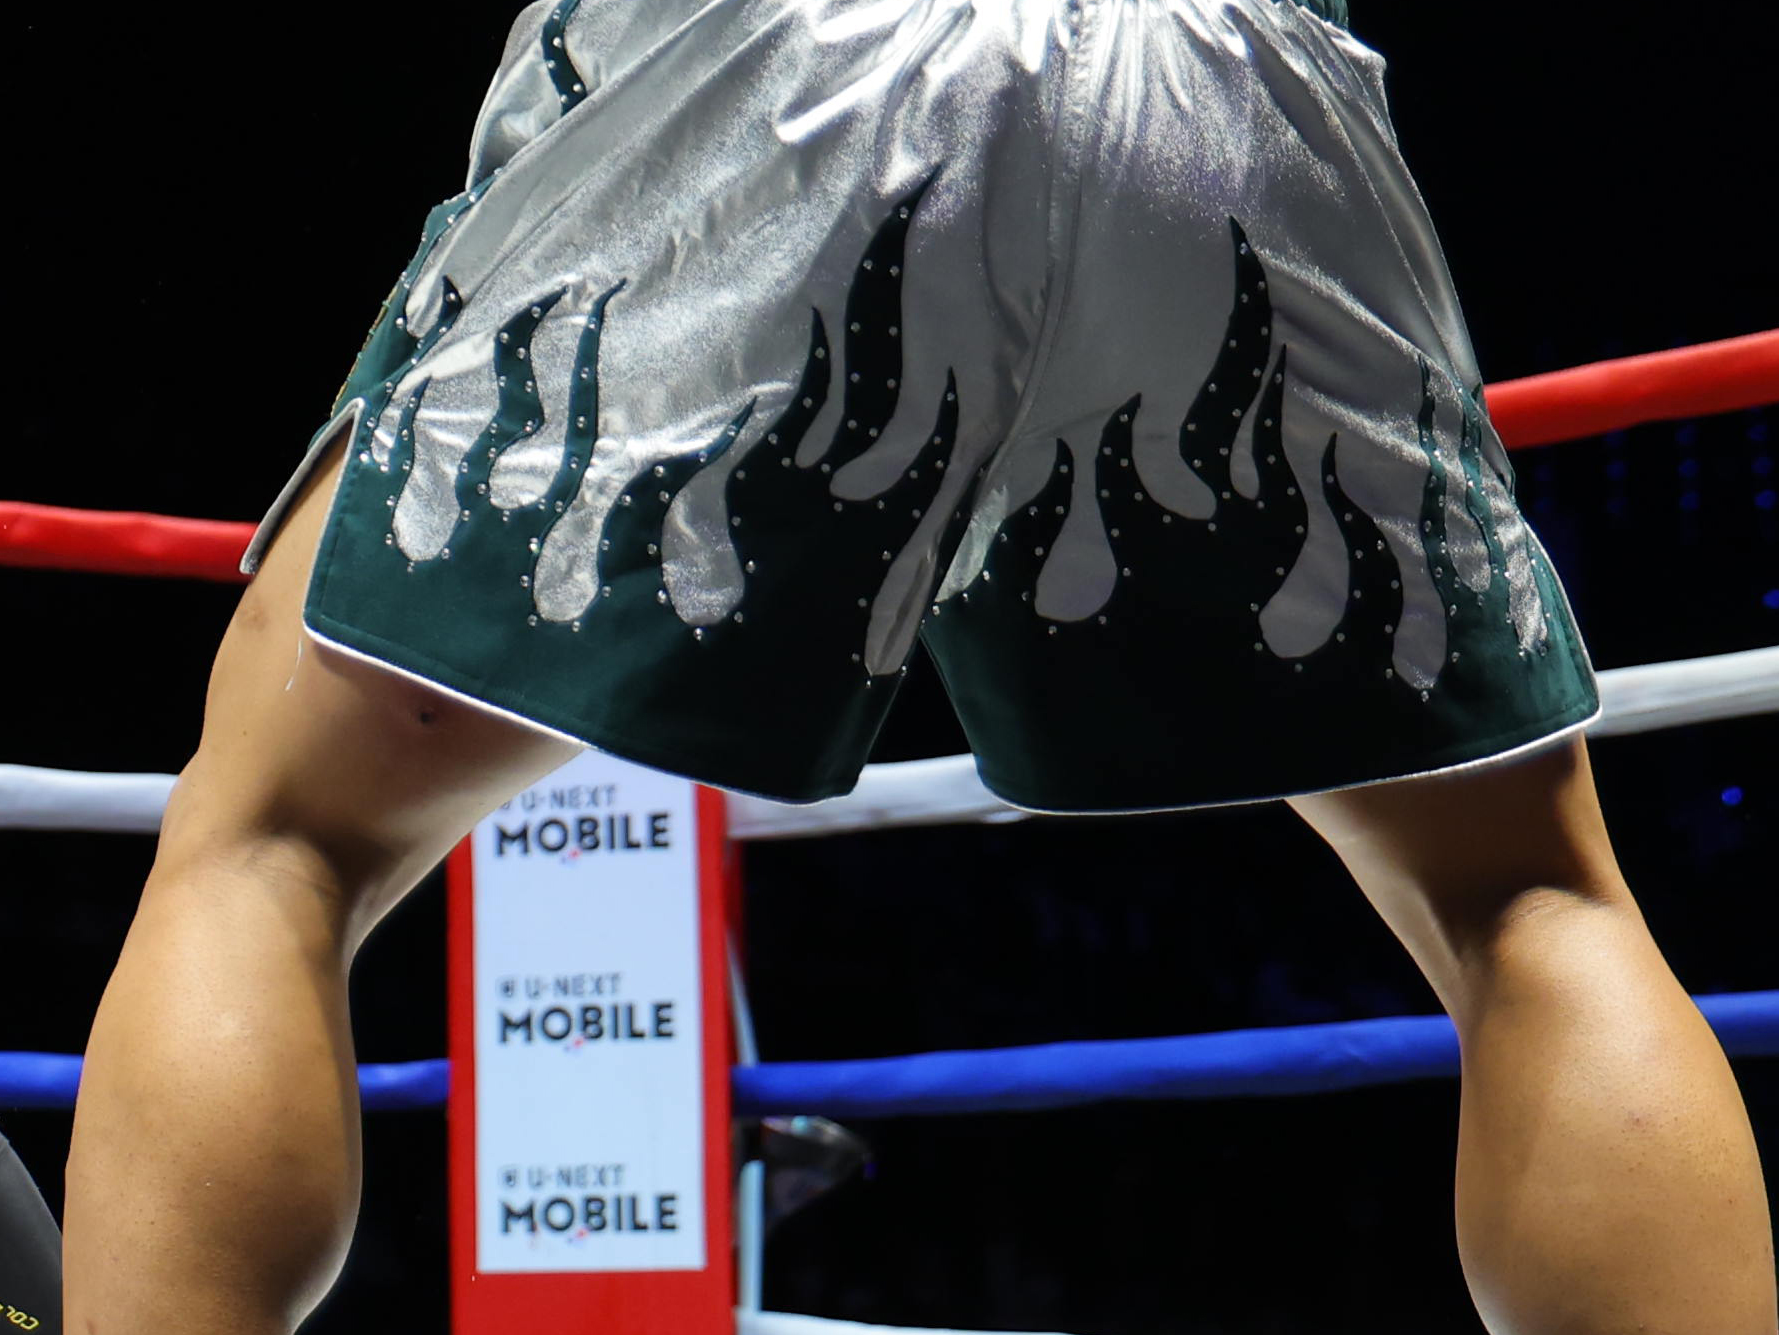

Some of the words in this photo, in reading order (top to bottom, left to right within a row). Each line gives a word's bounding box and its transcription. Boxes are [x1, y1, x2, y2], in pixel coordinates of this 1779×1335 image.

[521, 784, 617, 811] U-NEXT
[495, 812, 671, 857] MOBILE
[524, 972, 623, 998] U-NEXT
[499, 1001, 676, 1044] MOBILE
[527, 1163, 626, 1189] U-NEXT
[501, 1194, 680, 1234] MOBILE
